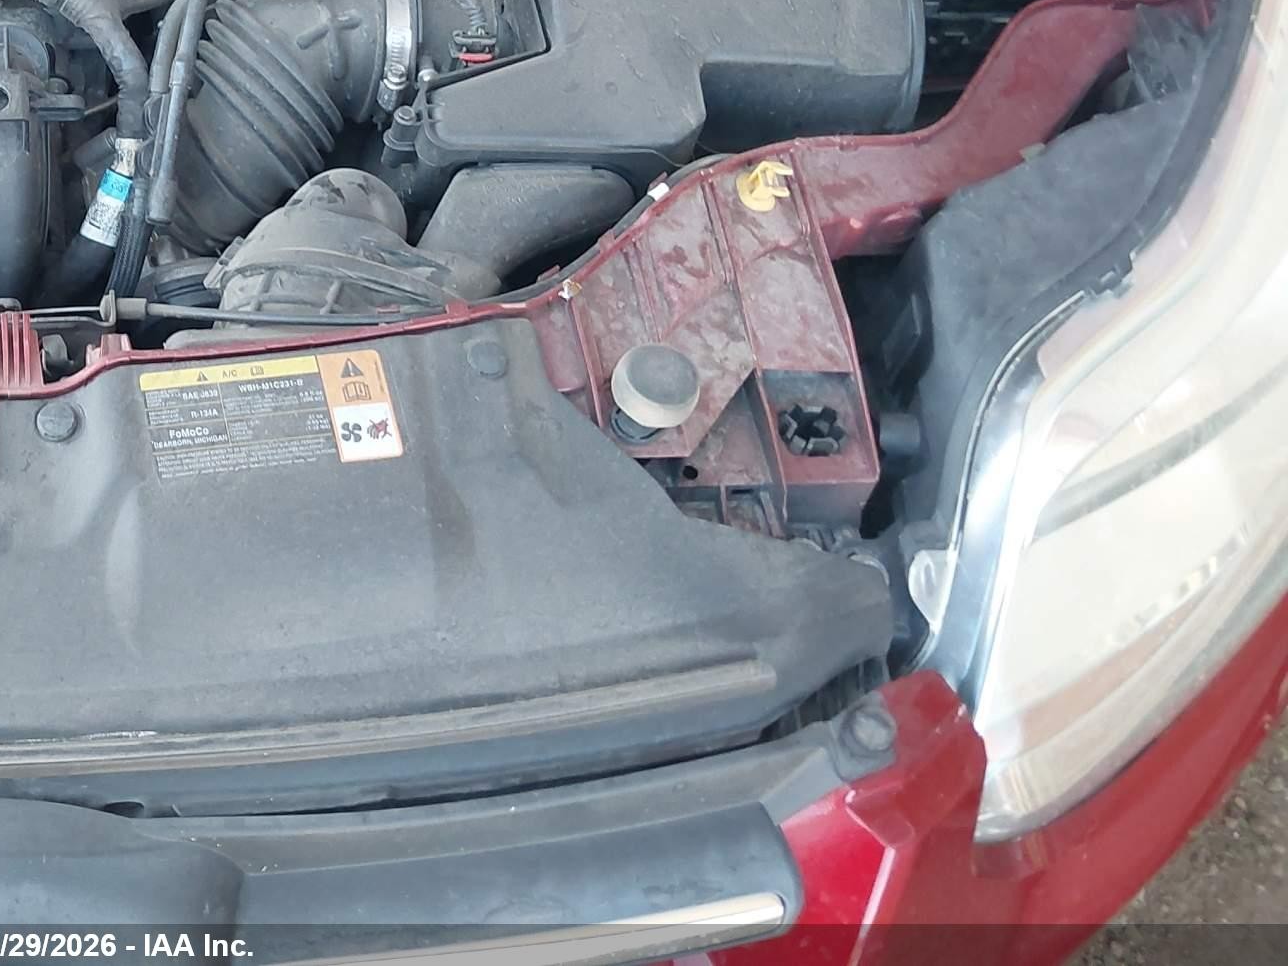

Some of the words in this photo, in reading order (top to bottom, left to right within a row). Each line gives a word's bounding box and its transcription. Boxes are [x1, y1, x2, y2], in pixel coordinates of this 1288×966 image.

[222, 369, 237, 378] A/C
[191, 408, 219, 419] R-134A
[168, 426, 210, 440] FoMoCo
[153, 438, 194, 450] DEARBORN,
[195, 433, 228, 445] MICHIGAN
